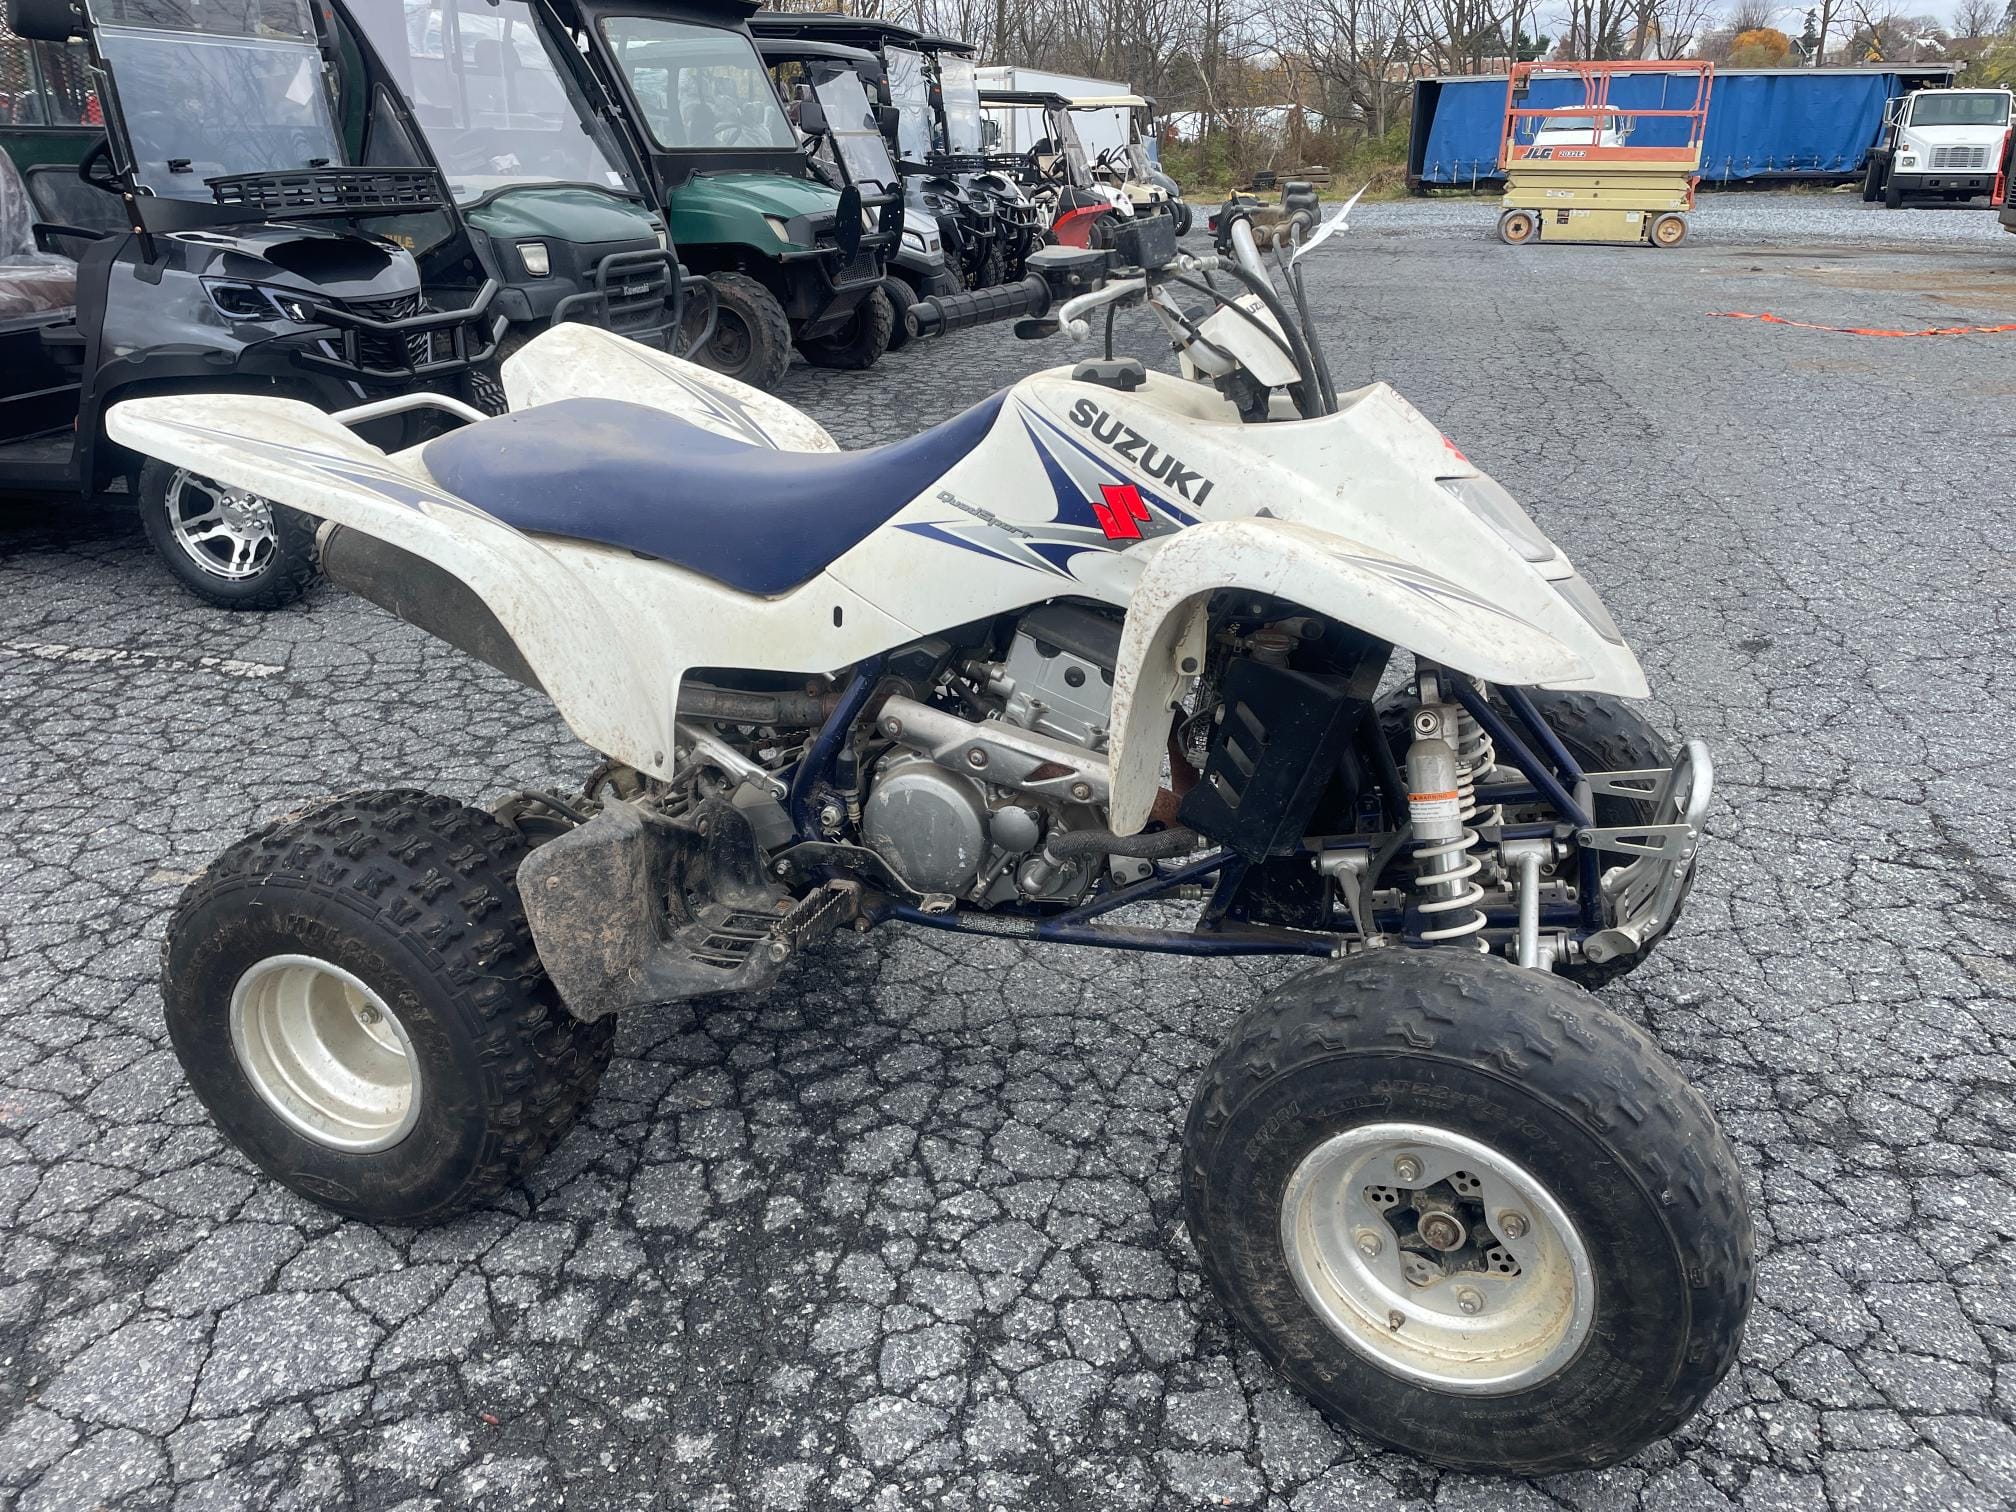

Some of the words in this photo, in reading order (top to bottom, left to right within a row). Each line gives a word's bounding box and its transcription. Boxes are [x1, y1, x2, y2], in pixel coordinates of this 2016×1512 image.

[1521, 147, 1553, 160] JLG
[623, 282, 650, 296] Kawasaki
[1069, 398, 1214, 506] SUZUKI
[937, 490, 1034, 539] QuadSport
